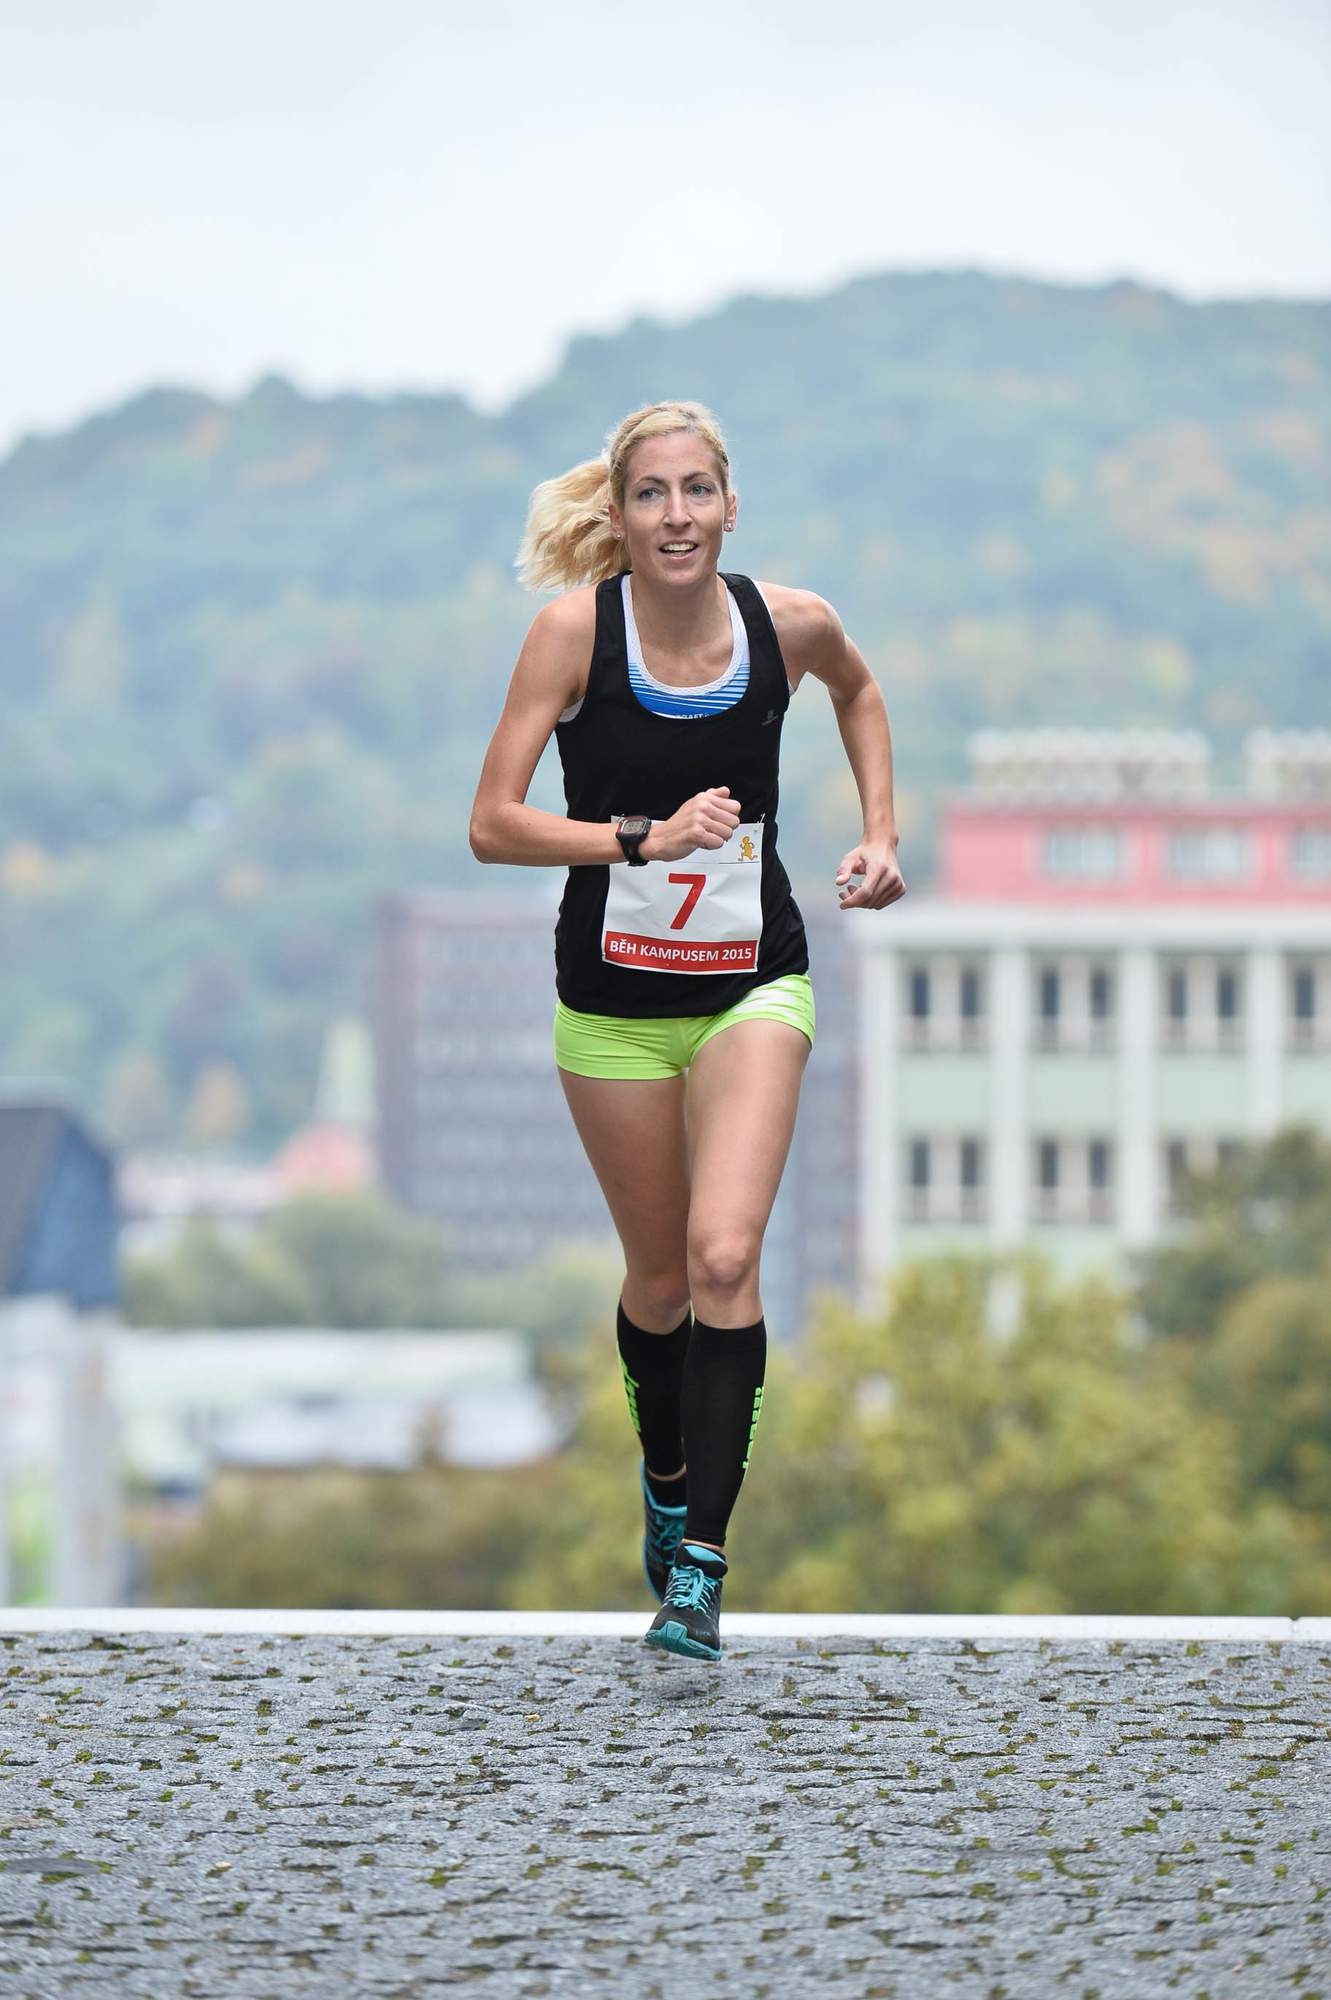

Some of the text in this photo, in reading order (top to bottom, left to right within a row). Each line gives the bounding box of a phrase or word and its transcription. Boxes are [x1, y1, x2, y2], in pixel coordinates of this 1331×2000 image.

[668, 873, 706, 929] 7
[610, 939, 752, 961] BĚH KAMPUSEM 2015
